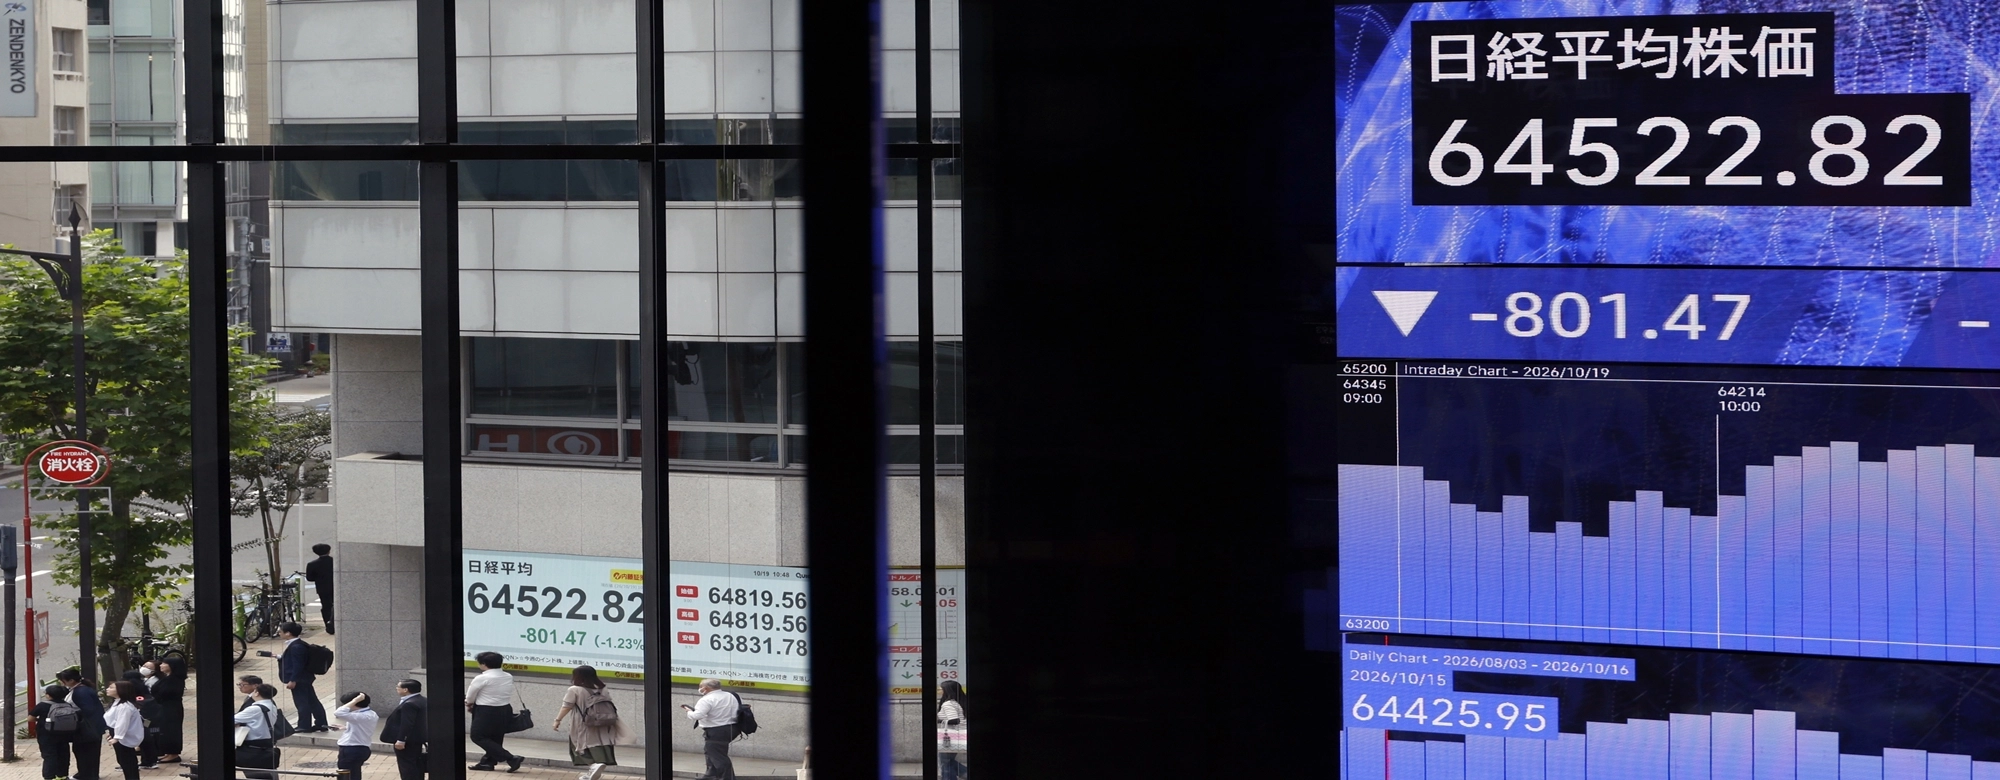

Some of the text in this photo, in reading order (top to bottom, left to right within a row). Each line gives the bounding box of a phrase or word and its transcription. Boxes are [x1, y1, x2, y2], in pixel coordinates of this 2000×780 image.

[9, 19, 26, 94] ZENDENKYO
[1430, 26, 1817, 82] 日経平均株価
[1428, 114, 1943, 187] 64522.82
[1469, 291, 1751, 341] -801.47
[1343, 363, 1387, 374] 65200
[1404, 364, 1463, 377] Intraday
[1467, 365, 1508, 377] Chart
[1523, 366, 1610, 379] 2026/10/19
[1343, 379, 1387, 389] 64345
[1717, 386, 1766, 397] 64214
[1343, 392, 1382, 403] 09:00
[1719, 400, 1761, 412] 10:00
[46, 458, 94, 472] 消火栓
[468, 560, 533, 577] 日経平均
[467, 581, 644, 624] 64522.82
[708, 587, 808, 609] 64819.56
[709, 610, 808, 633] 64819.56
[1346, 619, 1390, 630] 63200
[520, 628, 587, 646] -801.47
[709, 634, 808, 656] 63831.78
[1349, 650, 1384, 664] Daily
[1388, 652, 1428, 664] Chart
[1443, 655, 1527, 670] 2026/08/03
[1543, 661, 1629, 675] 2026/10/16
[1350, 669, 1447, 686] 2026/10/15
[1352, 694, 1546, 732] 64425.95
